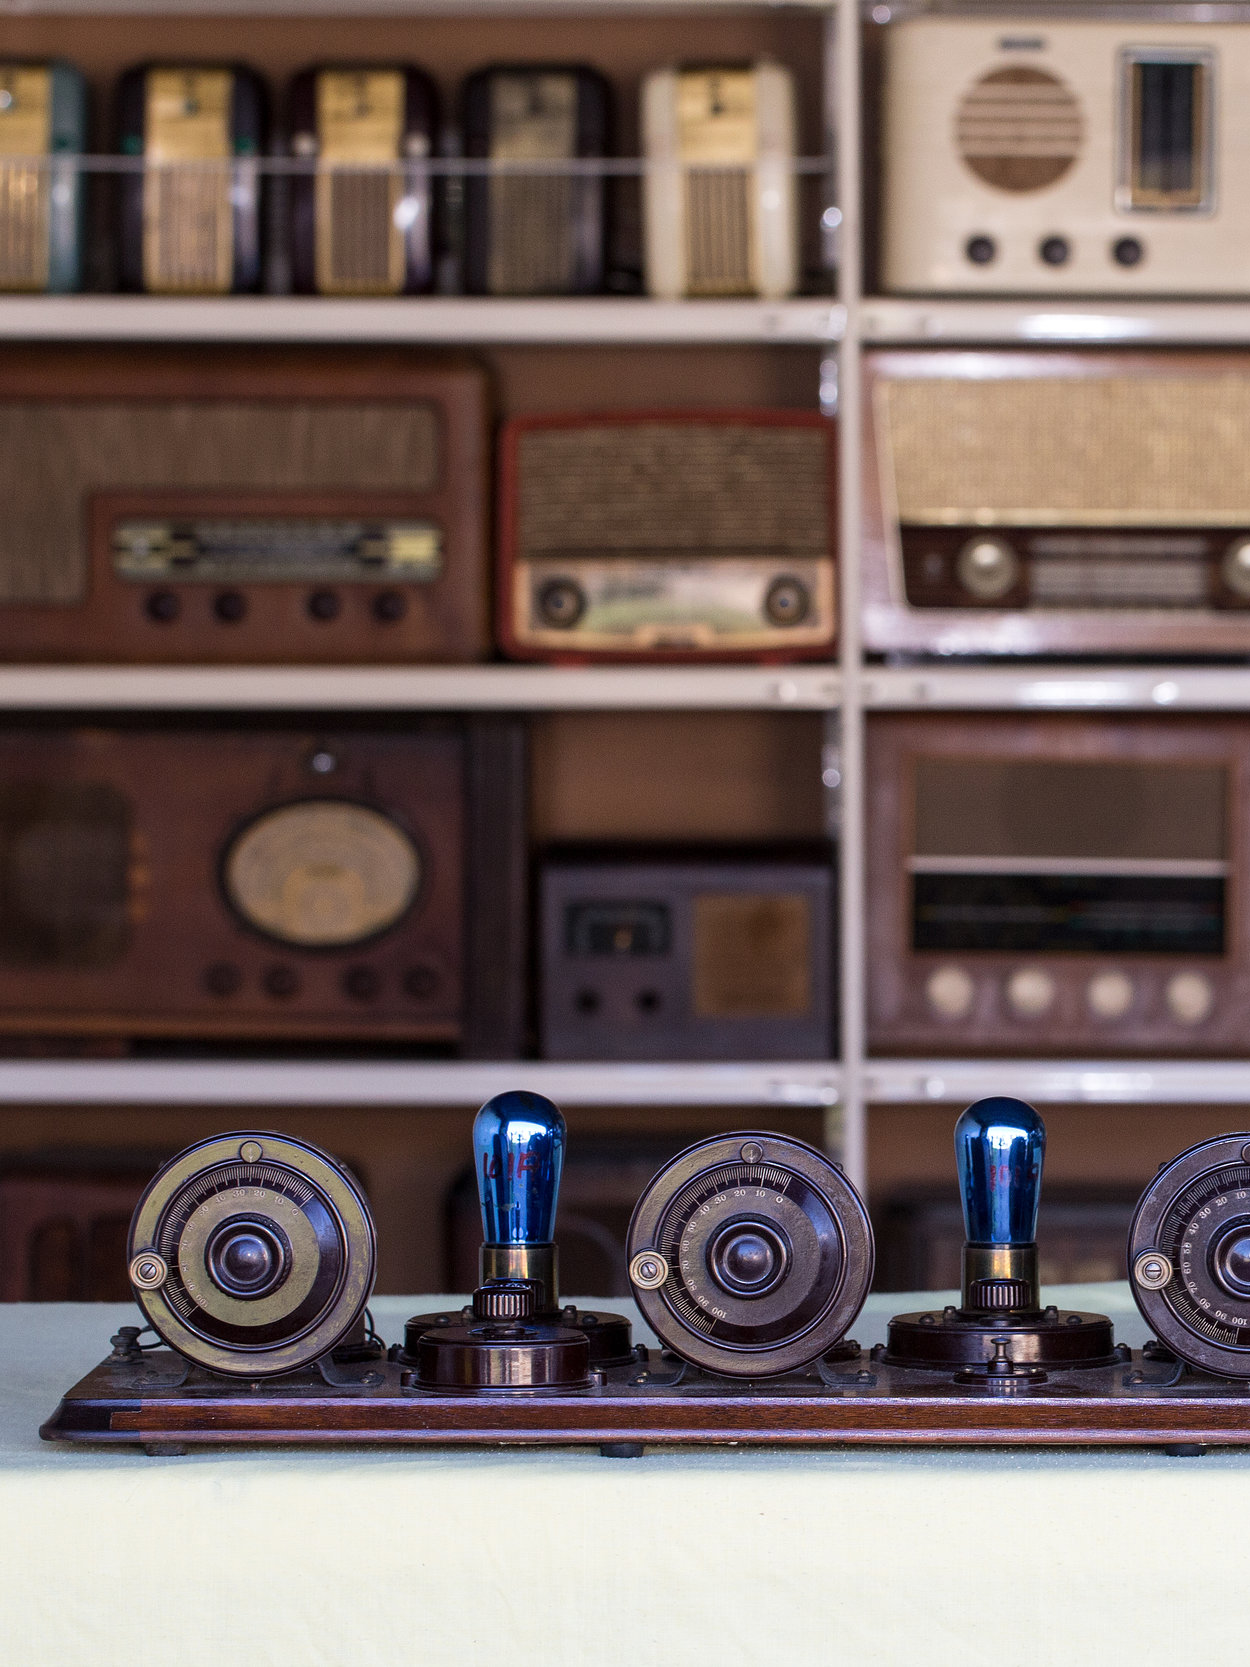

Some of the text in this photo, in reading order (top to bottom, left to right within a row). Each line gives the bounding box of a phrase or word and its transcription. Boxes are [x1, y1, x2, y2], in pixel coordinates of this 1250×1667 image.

[714, 1195, 726, 1204] 30
[1236, 1191, 1246, 1199] 10
[1216, 1196, 1228, 1206] 20
[700, 1206, 710, 1216] 40
[1200, 1208, 1212, 1218] 30
[688, 1222, 696, 1232] 50
[1189, 1223, 1199, 1234] 40
[682, 1240, 690, 1252] 60
[1184, 1242, 1192, 1254] 50
[682, 1260, 690, 1270] 70
[1183, 1262, 1191, 1274] 60
[688, 1280, 697, 1292] 80
[1189, 1281, 1198, 1294] 70
[698, 1296, 709, 1307] 90
[1200, 1298, 1210, 1310] 80
[712, 1307, 728, 1318] 100
[1216, 1310, 1228, 1320] 90
[1232, 1317, 1248, 1326] 100
